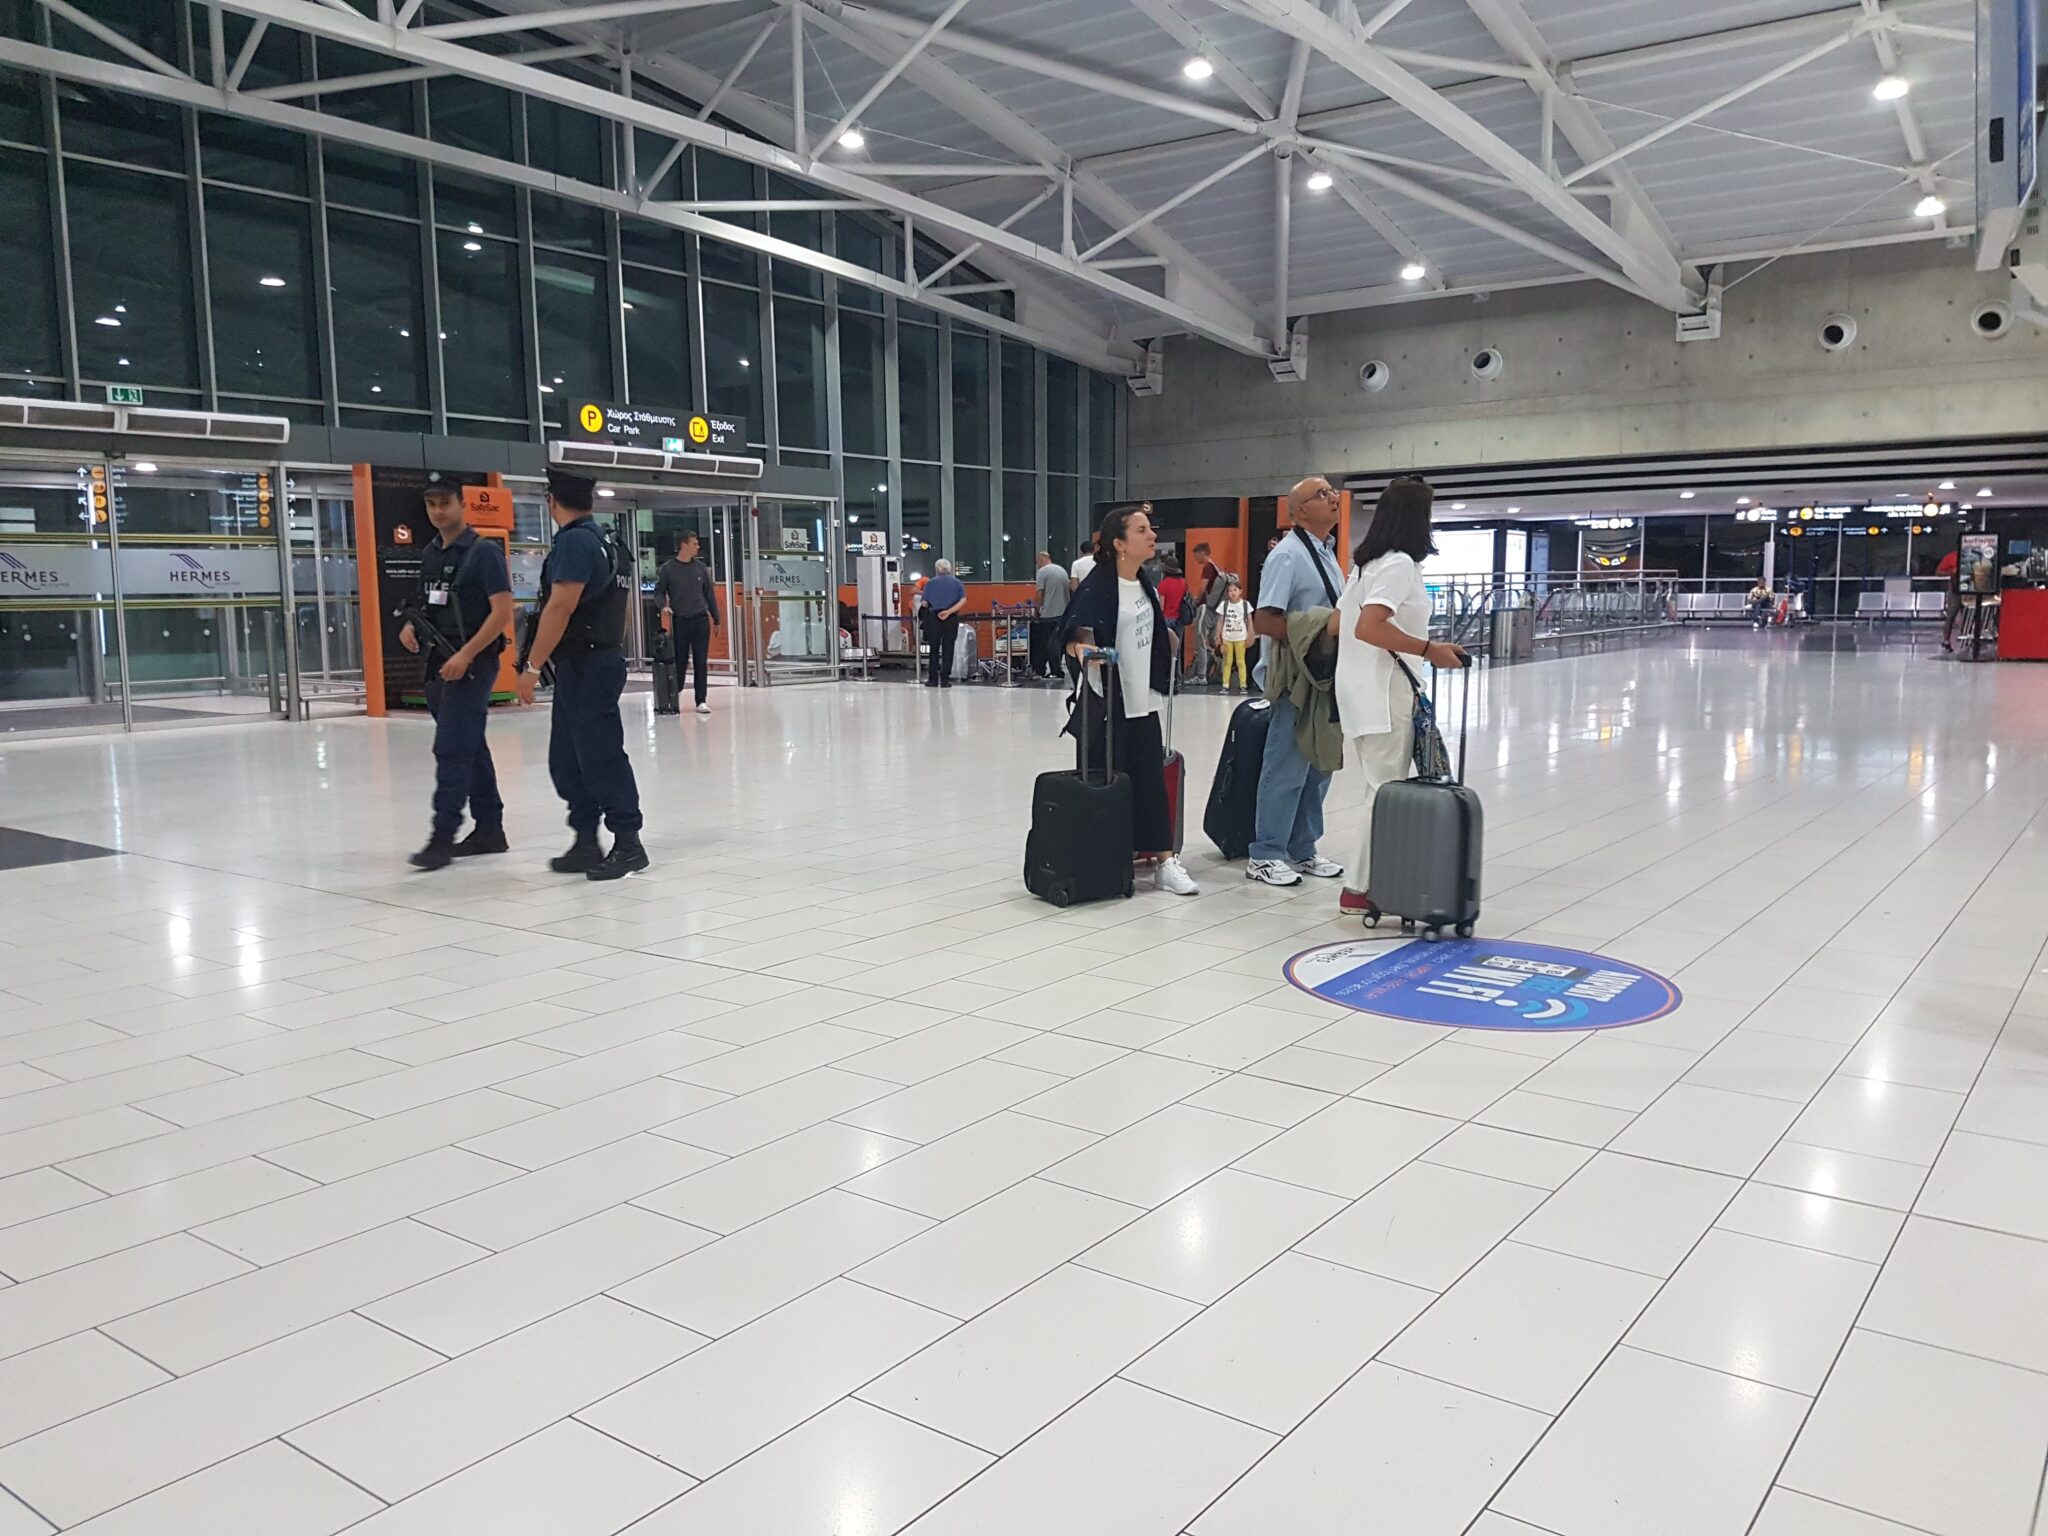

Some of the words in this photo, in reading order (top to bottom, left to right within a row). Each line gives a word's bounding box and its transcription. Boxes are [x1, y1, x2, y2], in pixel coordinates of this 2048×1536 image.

[606, 408, 633, 423] Χώρος
[633, 411, 676, 428] Στάθμευσης
[607, 423, 621, 434] Car
[623, 424, 641, 436] Park
[710, 420, 736, 434] Έξοδος
[711, 433, 725, 444] Exit
[784, 539, 807, 550] SafeSac
[863, 542, 885, 552] SafeSac
[0, 571, 60, 586] ERMES
[168, 571, 231, 586] HERMES
[615, 574, 633, 589] POLI
[769, 575, 801, 586] HERMES
